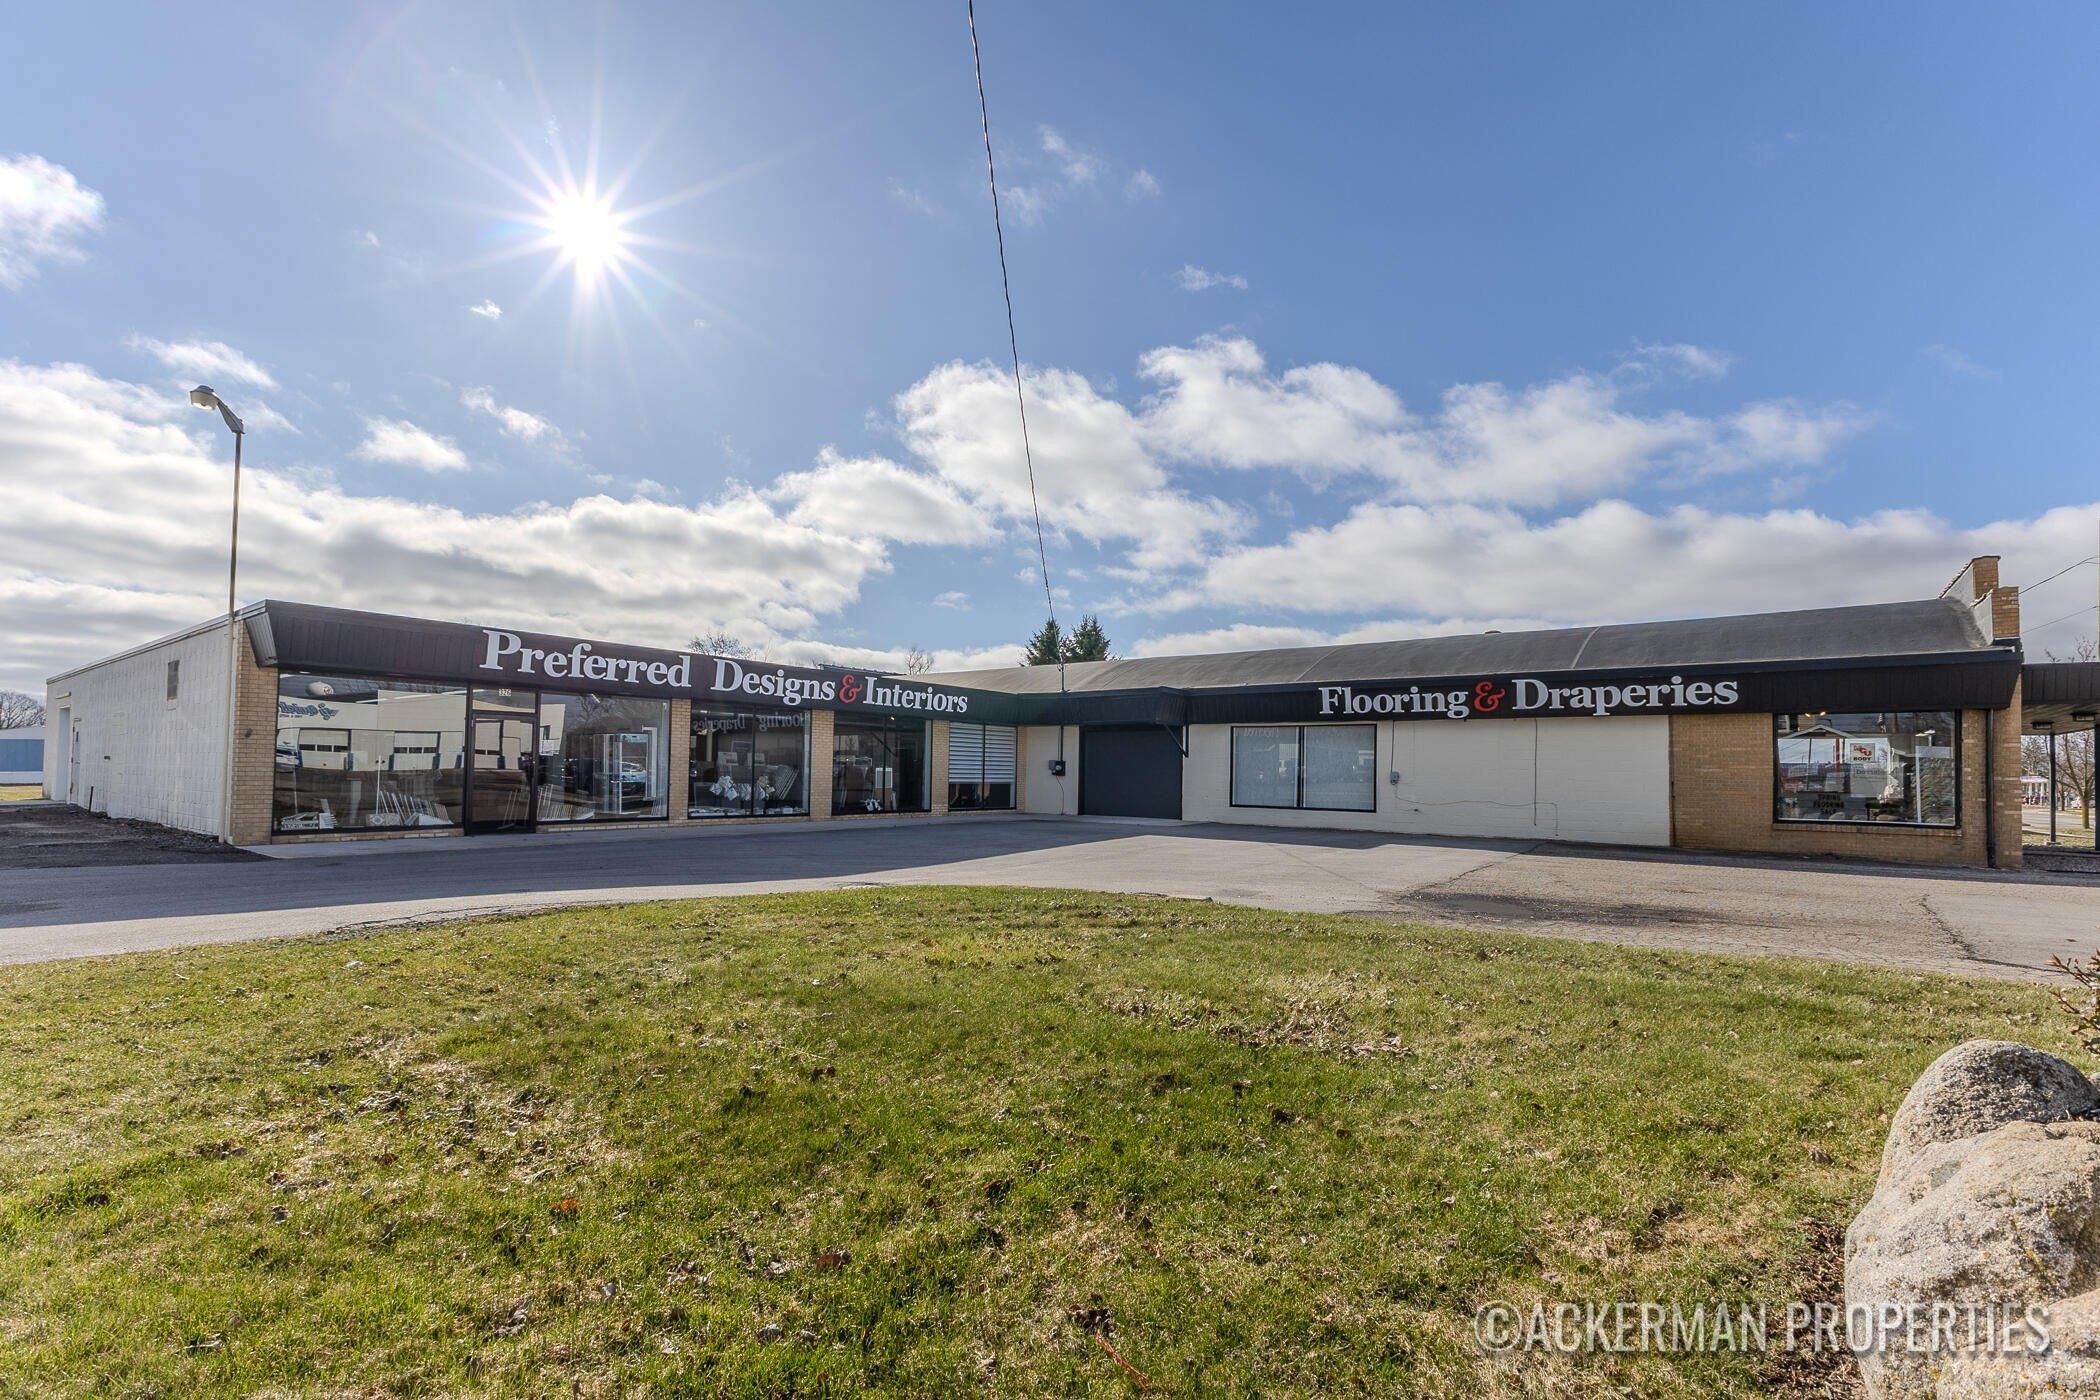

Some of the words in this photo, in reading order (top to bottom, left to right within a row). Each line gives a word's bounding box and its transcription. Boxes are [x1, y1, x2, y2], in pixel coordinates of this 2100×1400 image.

[480, 629, 692, 687] Preferred
[710, 658, 836, 706] Designs
[862, 677, 969, 714] Interiors
[1318, 685, 1469, 719] Flooring
[1511, 675, 1739, 716] Draperies
